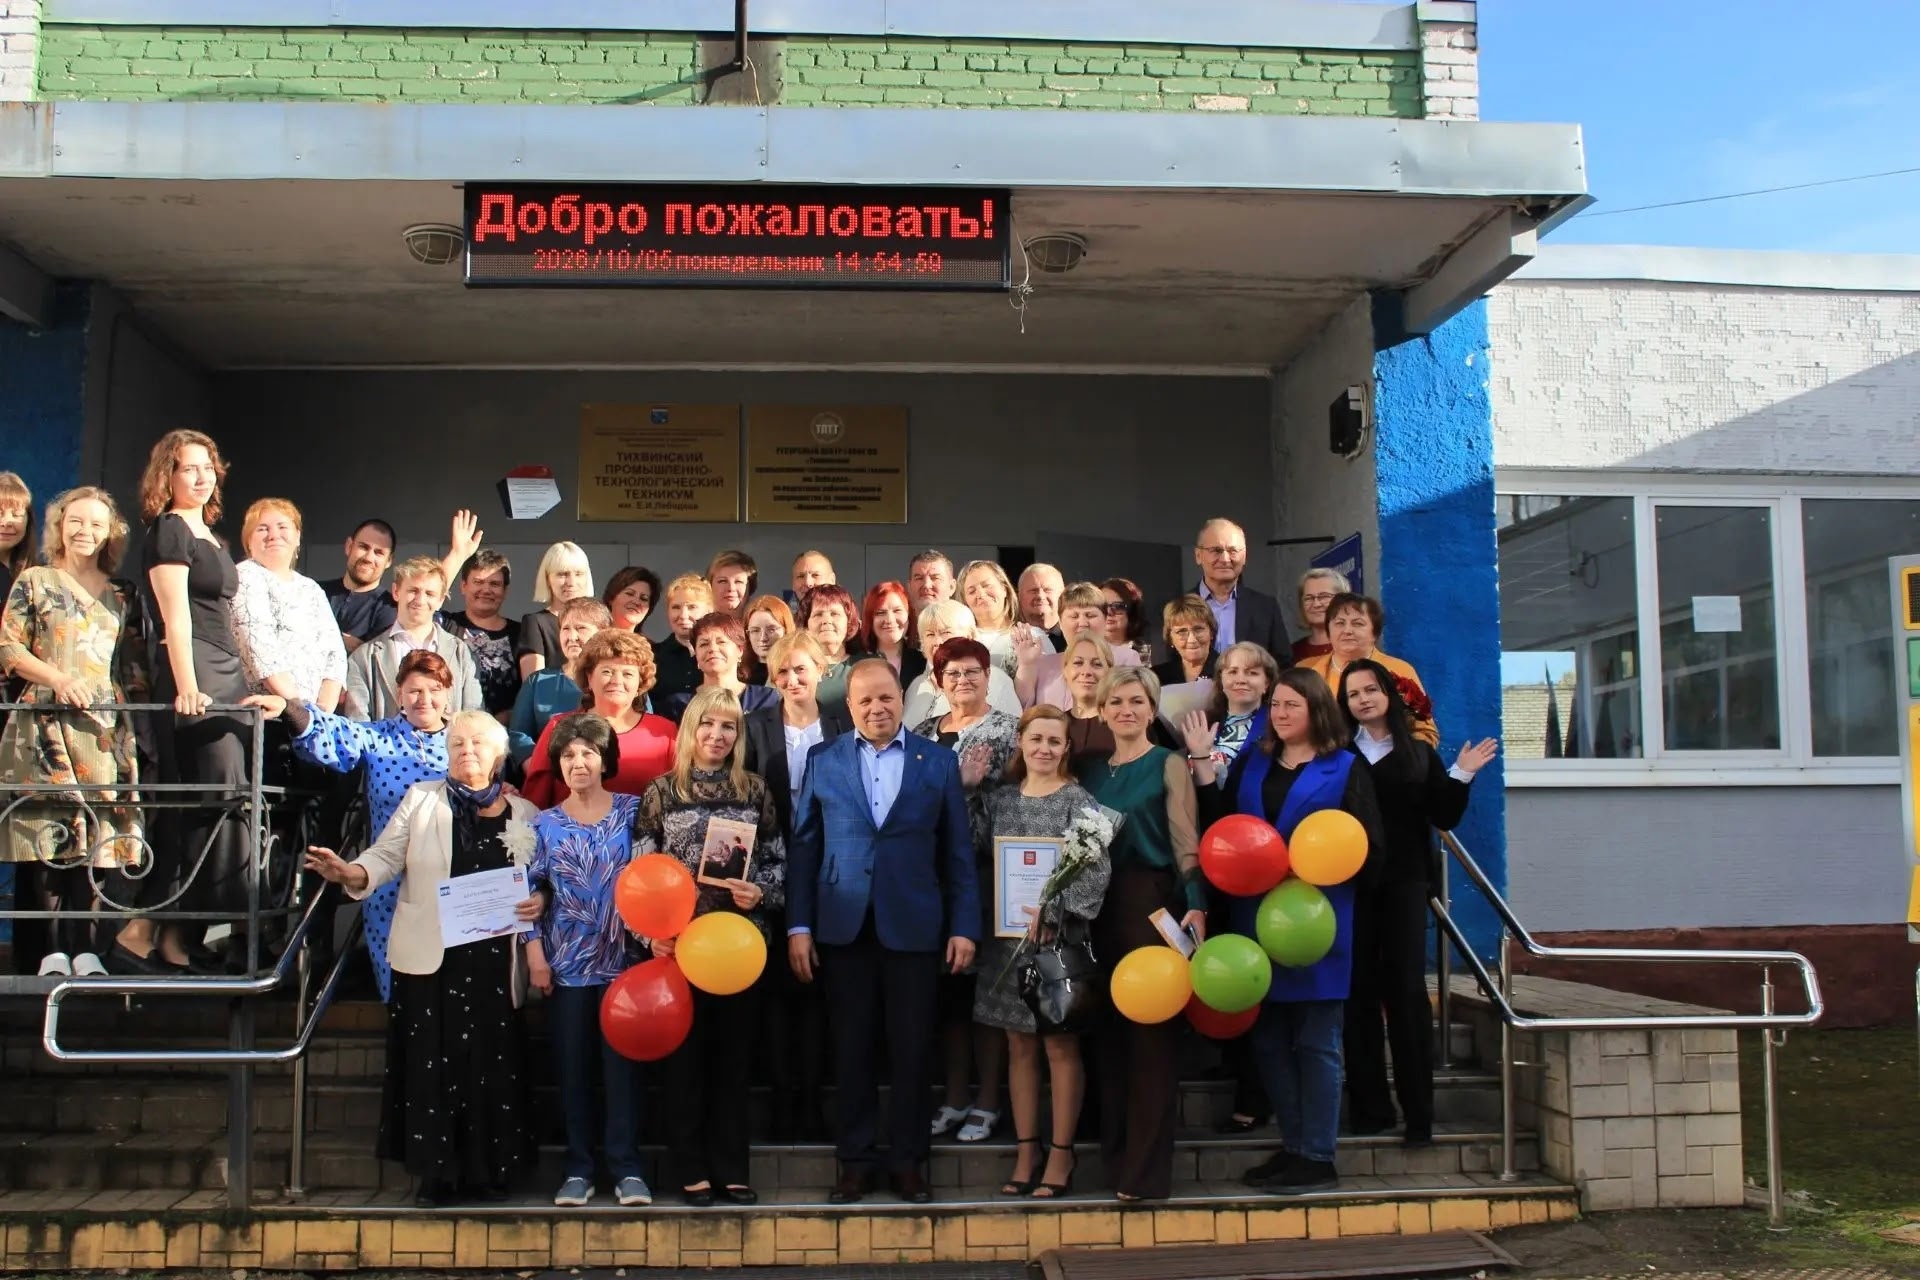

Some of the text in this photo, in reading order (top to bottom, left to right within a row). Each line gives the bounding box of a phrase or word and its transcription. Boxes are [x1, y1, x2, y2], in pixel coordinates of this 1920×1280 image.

[475, 194, 993, 244] Добро пожаловать!
[534, 249, 941, 273] 2026/10/05 понедельник 14:54:59
[617, 451, 703, 463] ТИХВИНСКИЙ
[605, 464, 712, 475] ПРОМЫШЛЕННО-
[595, 476, 724, 488] ТЕХНОЛОГИЧЕСКИЙ
[624, 489, 694, 500] ТЕХНИКУМ
